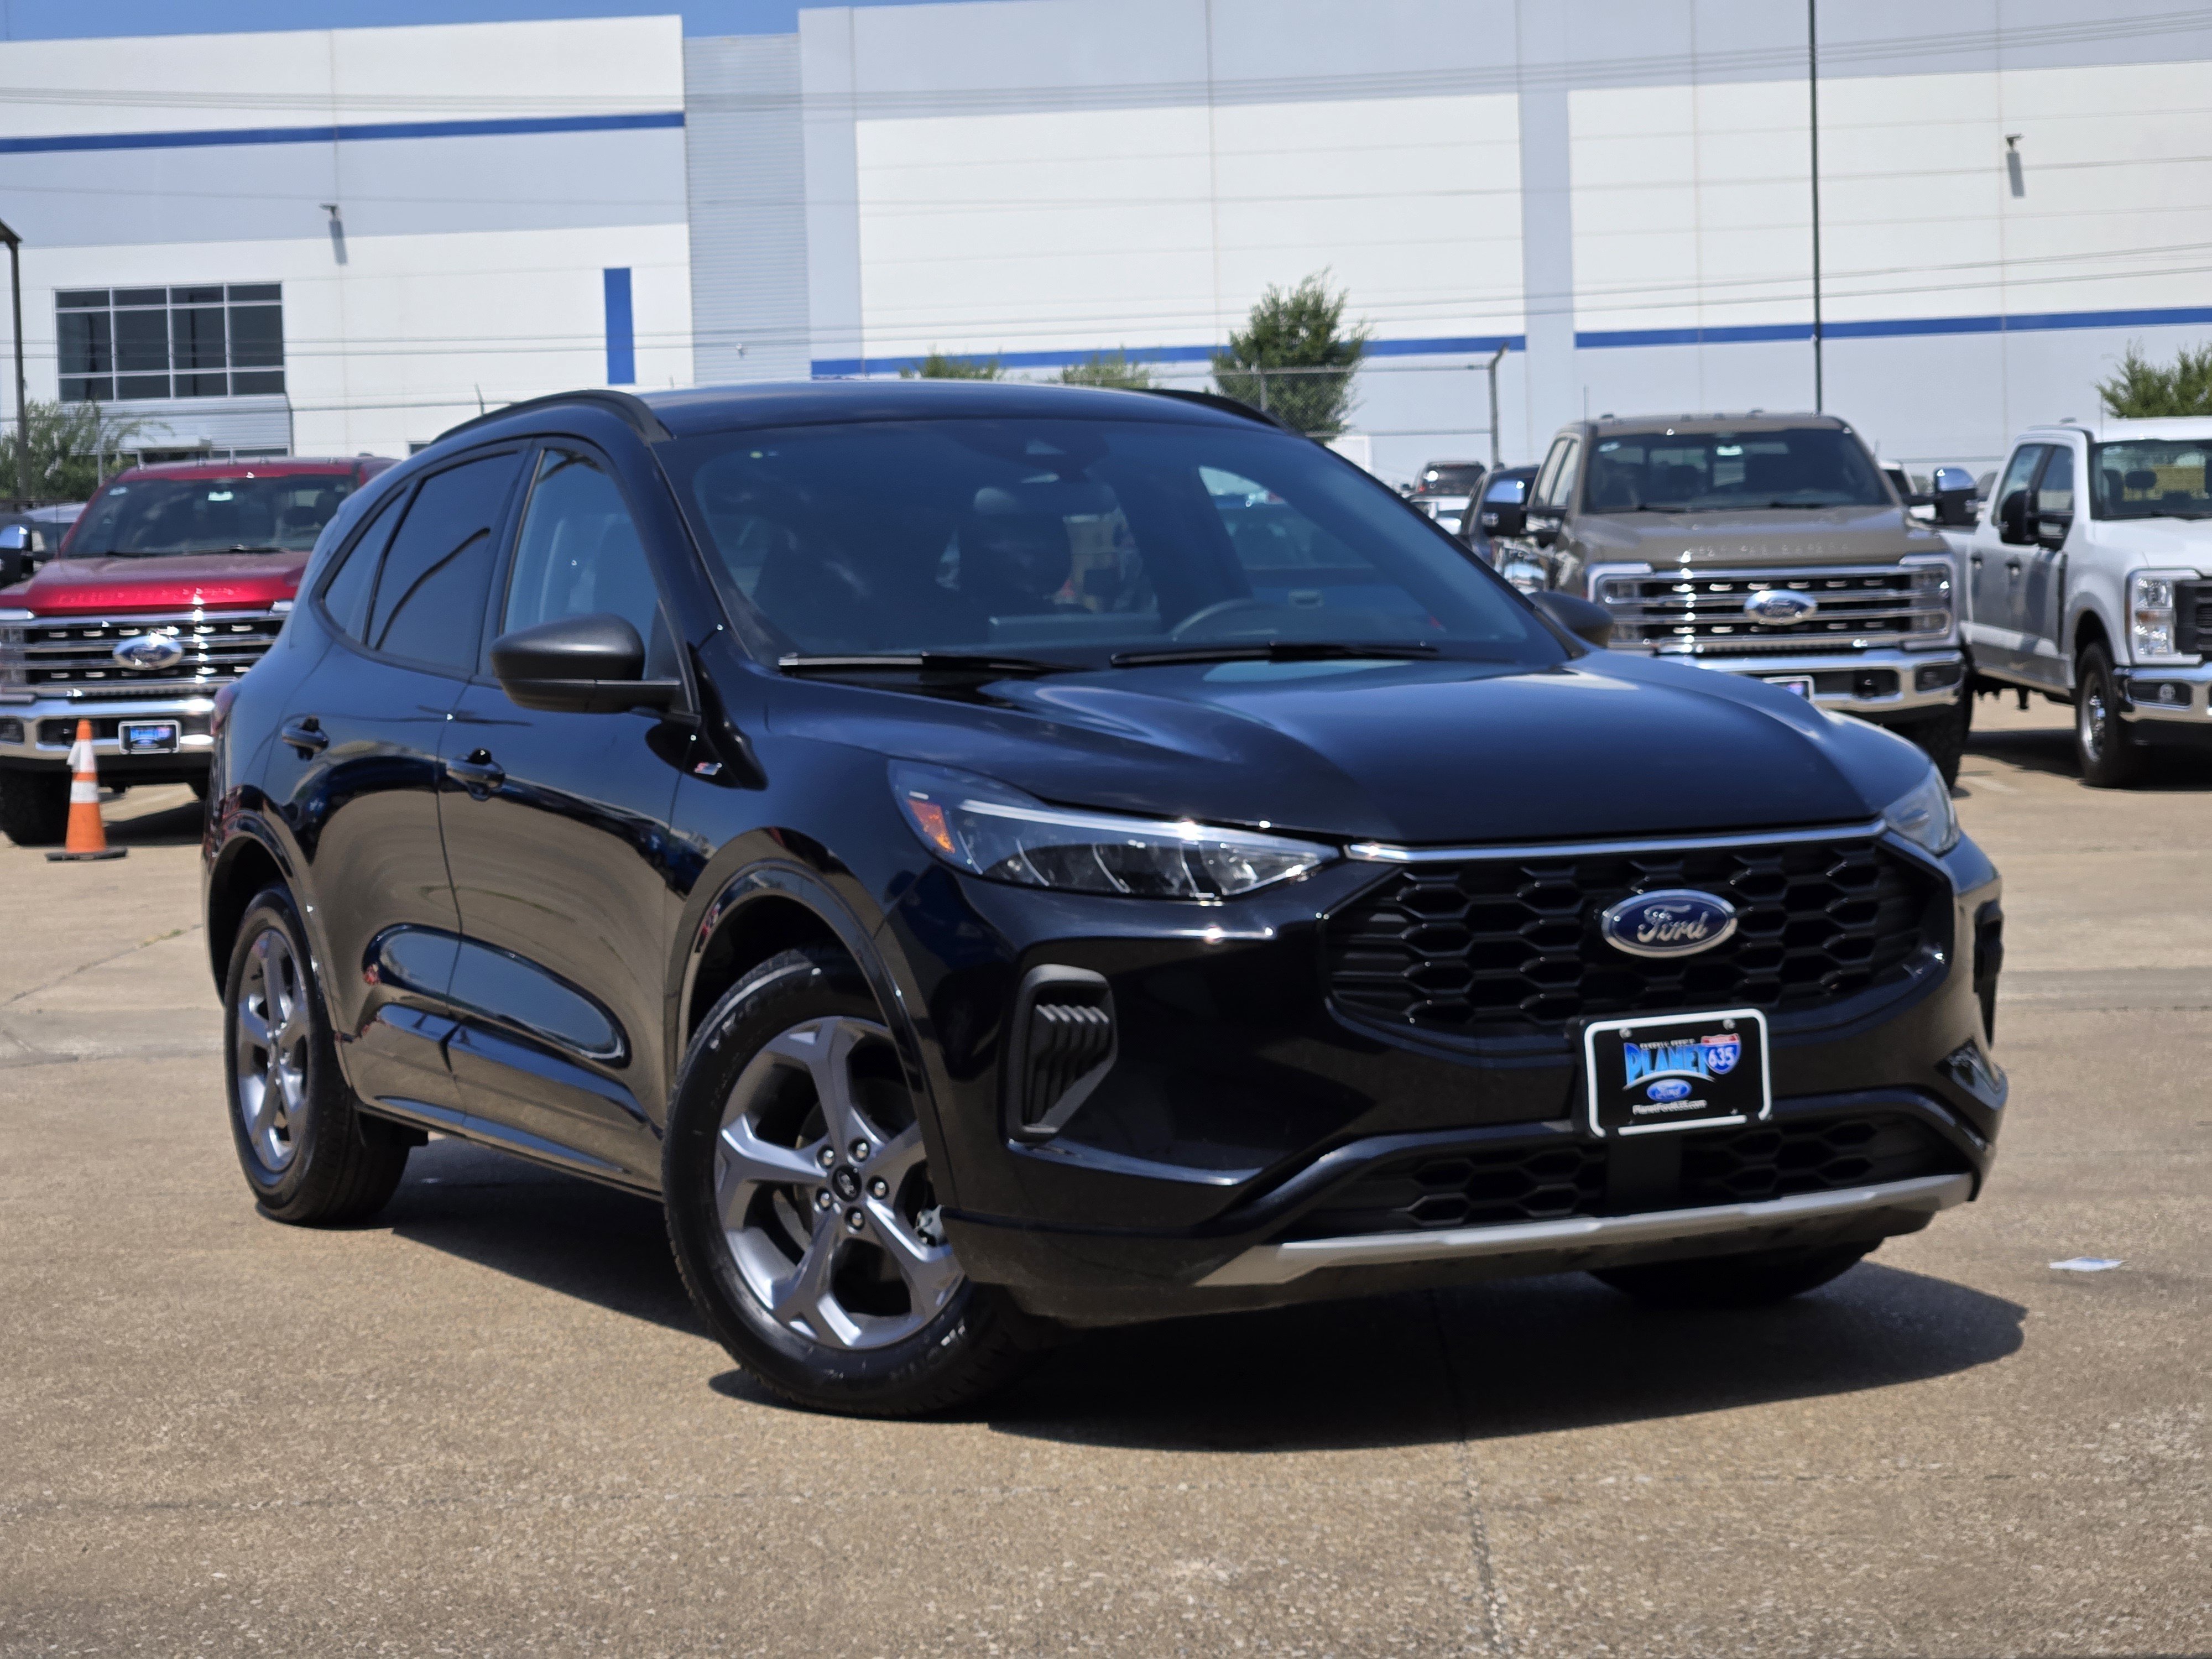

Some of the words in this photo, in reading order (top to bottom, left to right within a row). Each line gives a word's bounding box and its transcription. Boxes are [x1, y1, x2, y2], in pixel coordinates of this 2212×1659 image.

[1764, 601, 1795, 614] Ford
[1637, 904, 1709, 943] Ford
[1624, 1042, 1710, 1085] PLANET
[1708, 1046, 1735, 1067] 635
